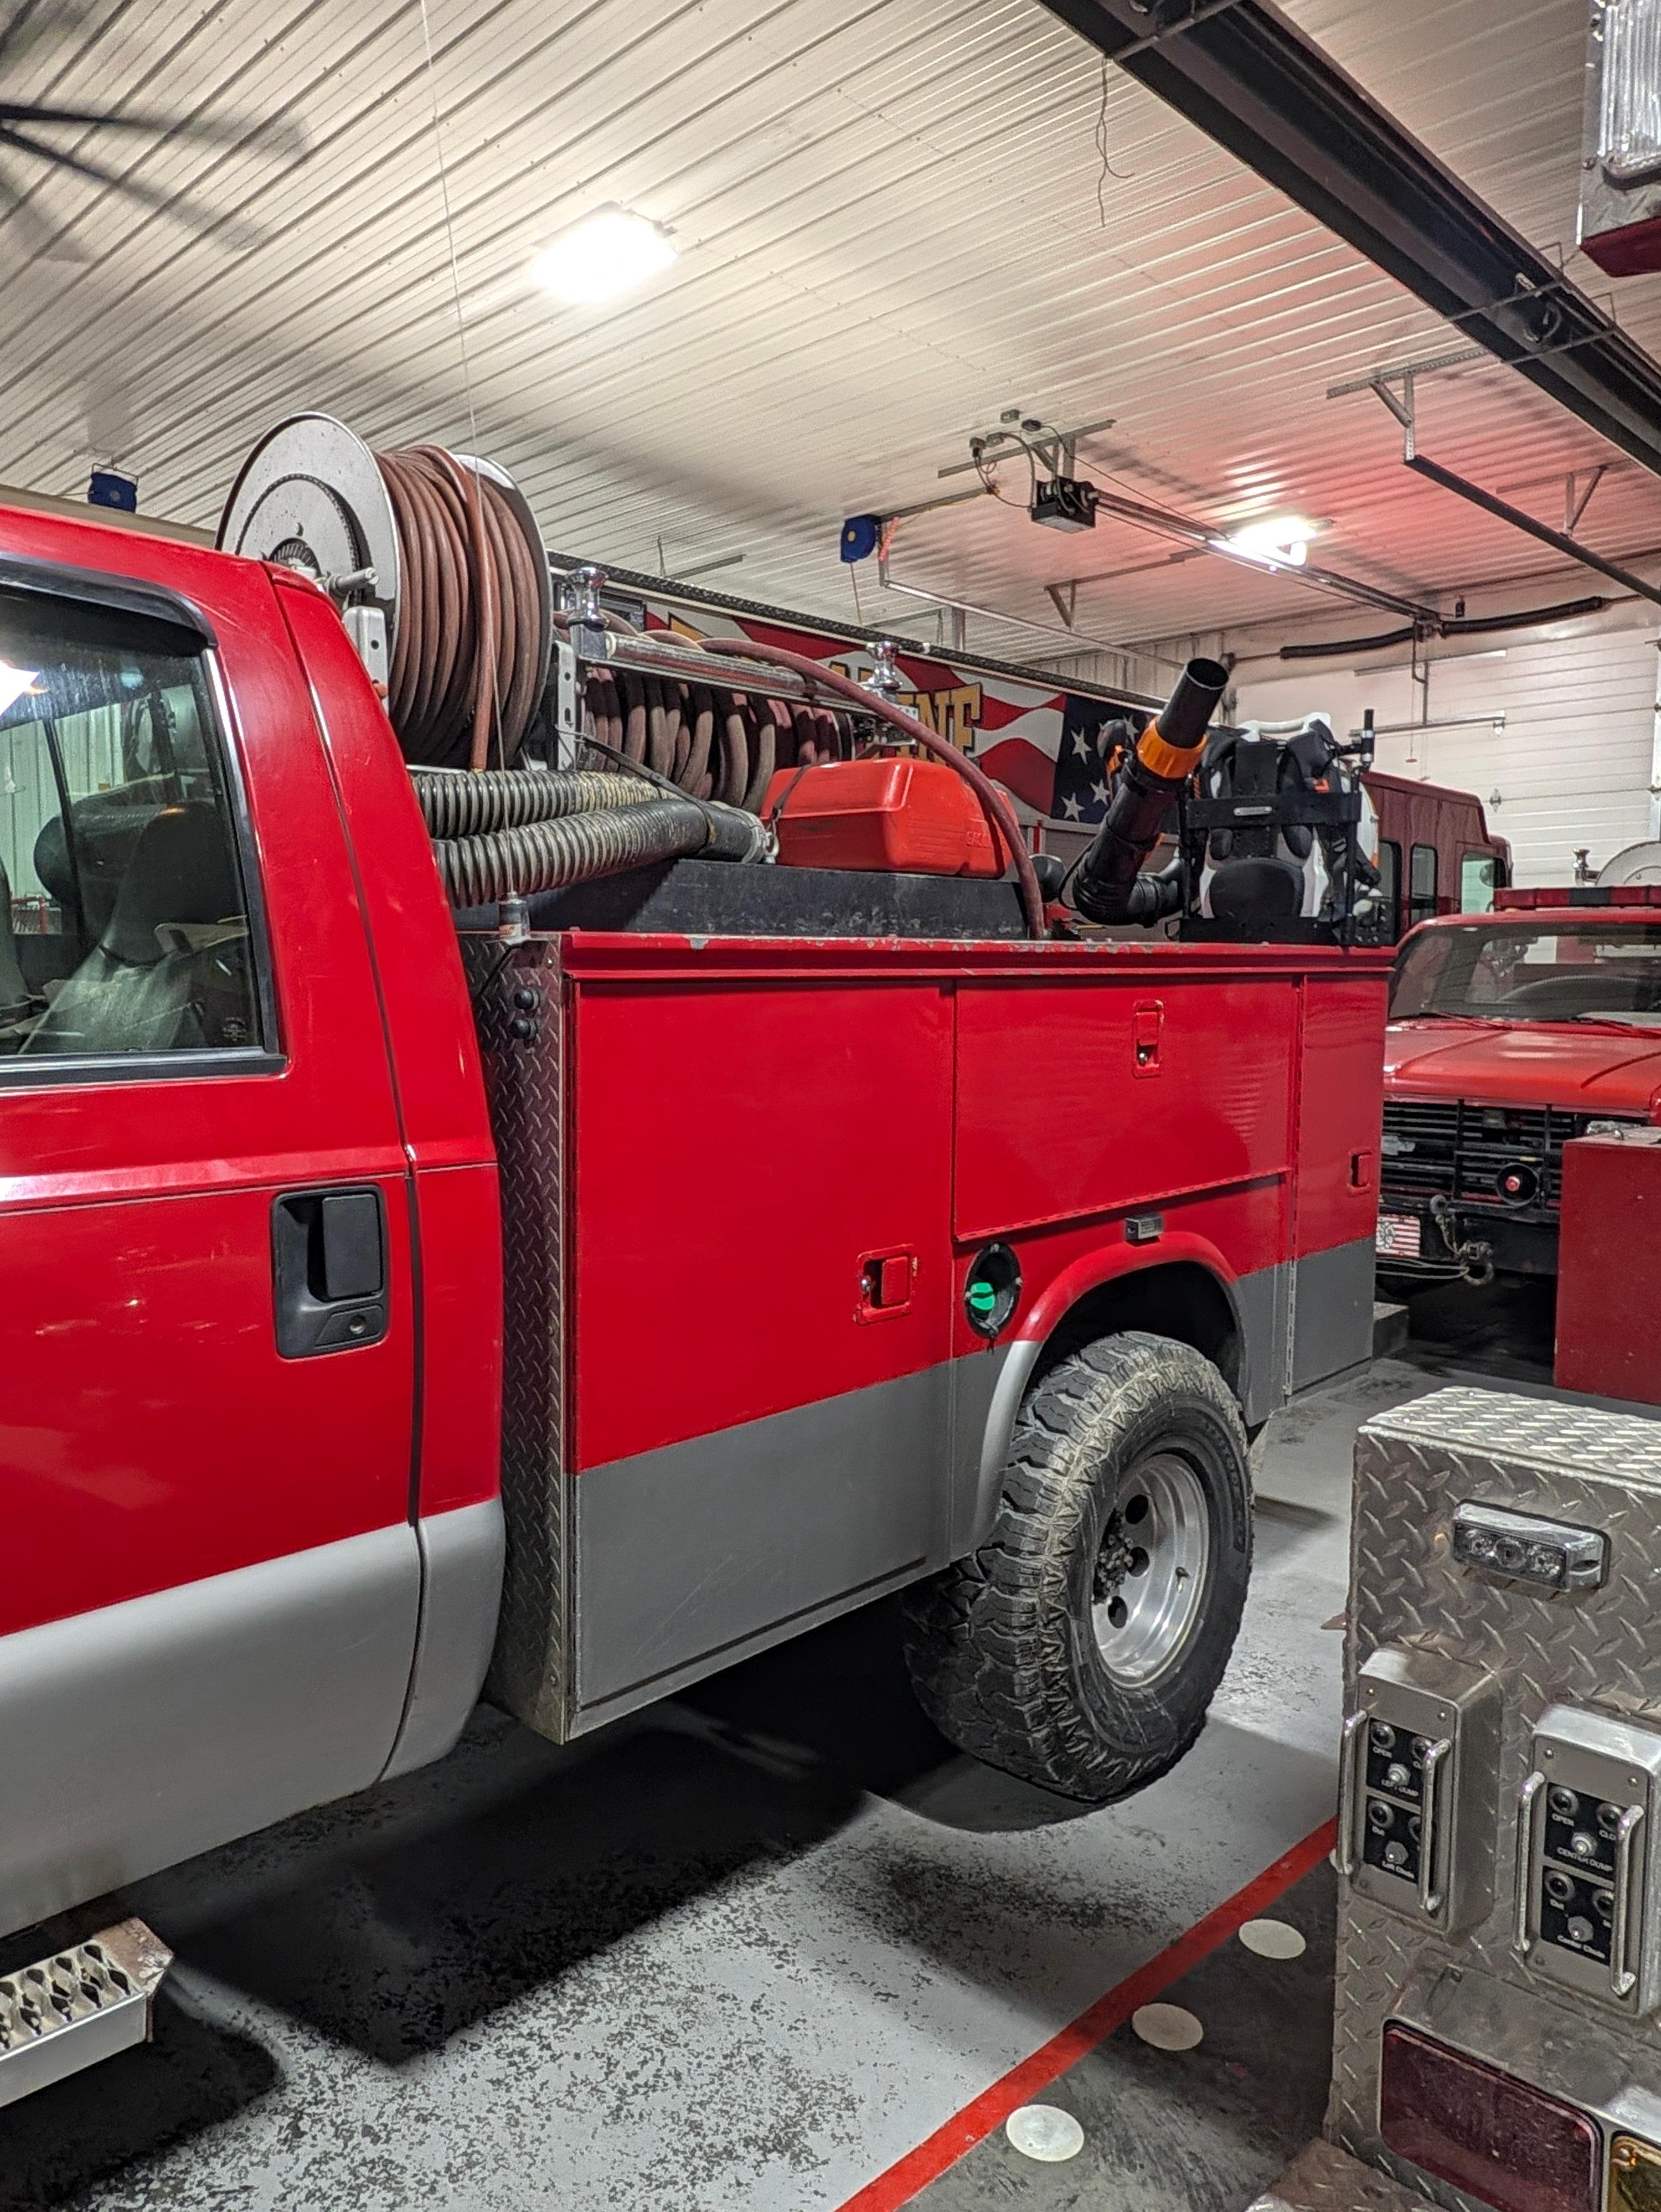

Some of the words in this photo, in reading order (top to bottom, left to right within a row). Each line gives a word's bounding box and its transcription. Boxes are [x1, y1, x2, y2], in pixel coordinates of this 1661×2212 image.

[1373, 1746, 1392, 1759] OPEN
[1551, 1813, 1575, 1827] OPEN
[1599, 1829, 1617, 1841] CLO
[1556, 1847, 1588, 1864] CENTER
[1589, 1858, 1613, 1871] DUMP
